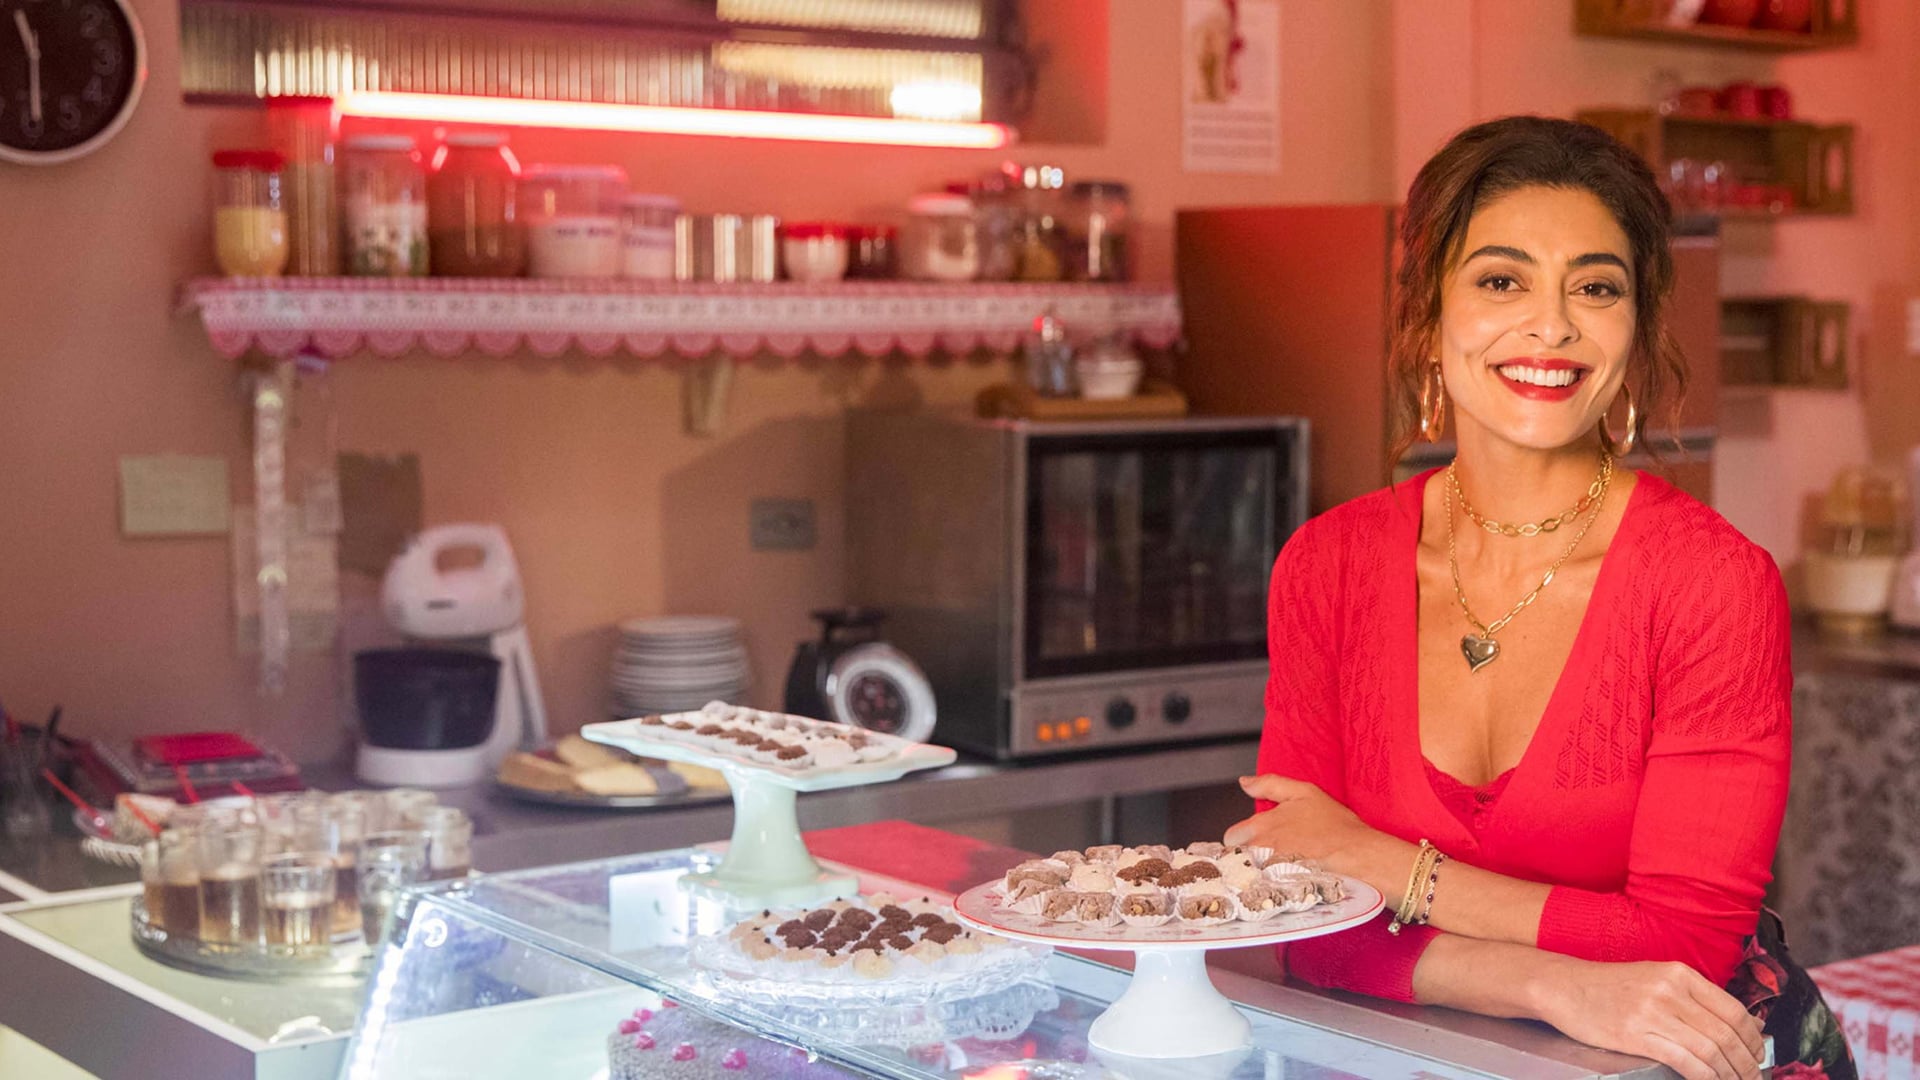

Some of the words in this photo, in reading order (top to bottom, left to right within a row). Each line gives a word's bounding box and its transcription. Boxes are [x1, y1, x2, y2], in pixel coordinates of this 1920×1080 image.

[80, 4, 102, 38] 2
[92, 39, 116, 76] 3
[82, 75, 102, 106] 4
[57, 95, 81, 131] 5
